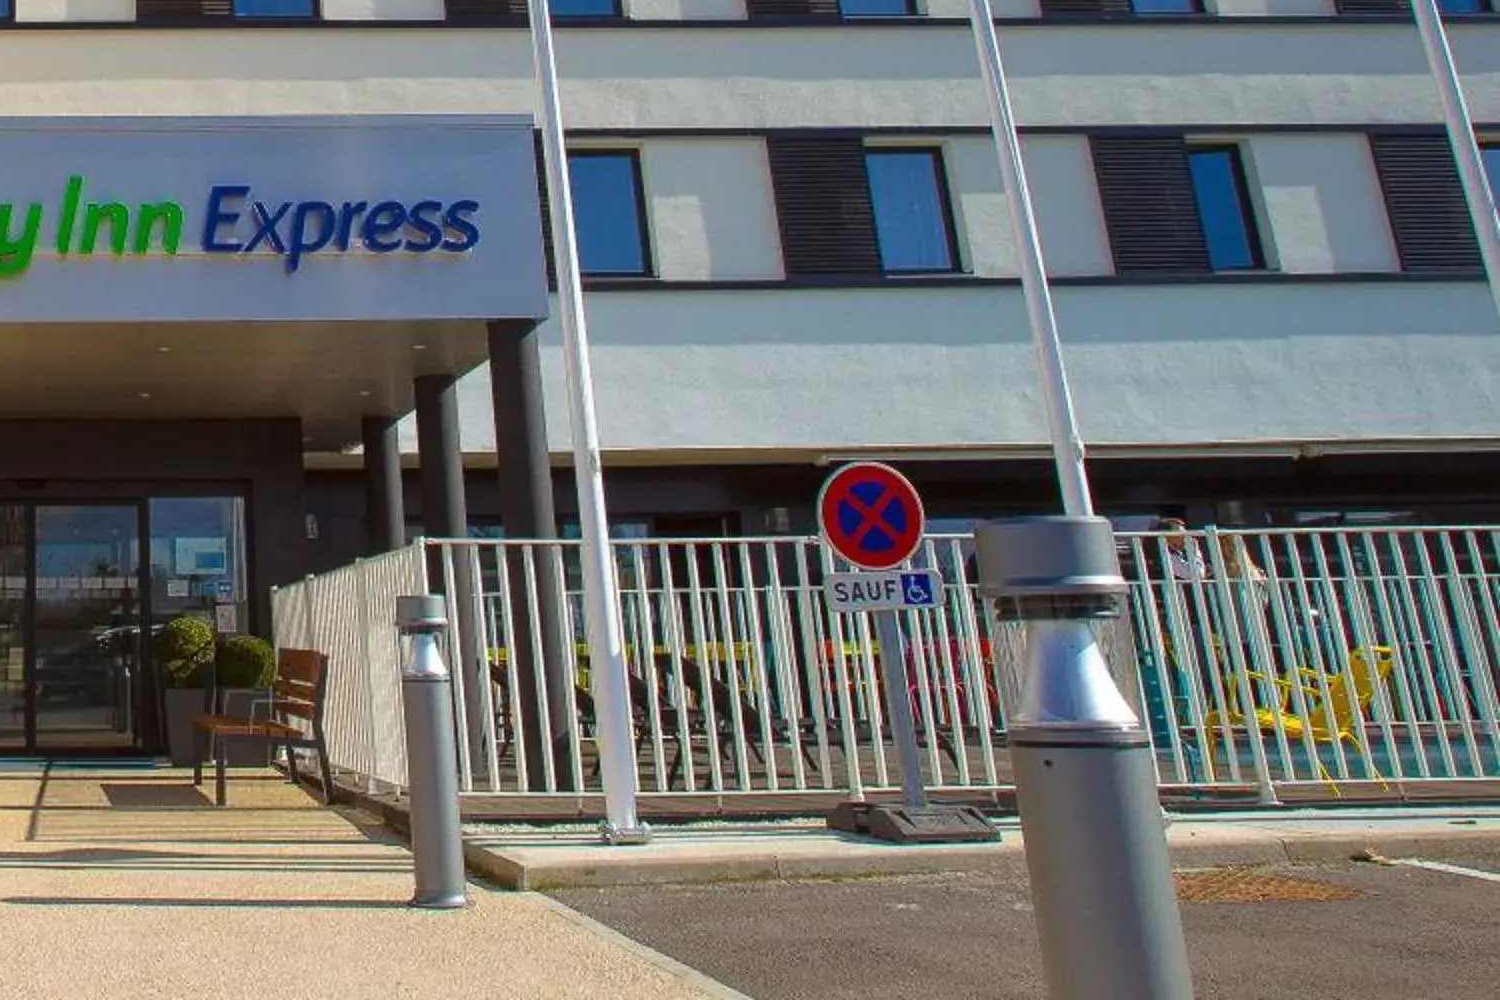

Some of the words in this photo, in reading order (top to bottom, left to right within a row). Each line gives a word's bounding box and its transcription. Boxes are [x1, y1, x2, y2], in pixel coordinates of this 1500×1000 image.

[56, 174, 185, 257] Inn
[202, 185, 480, 273] Express
[834, 580, 896, 602] SAUF
